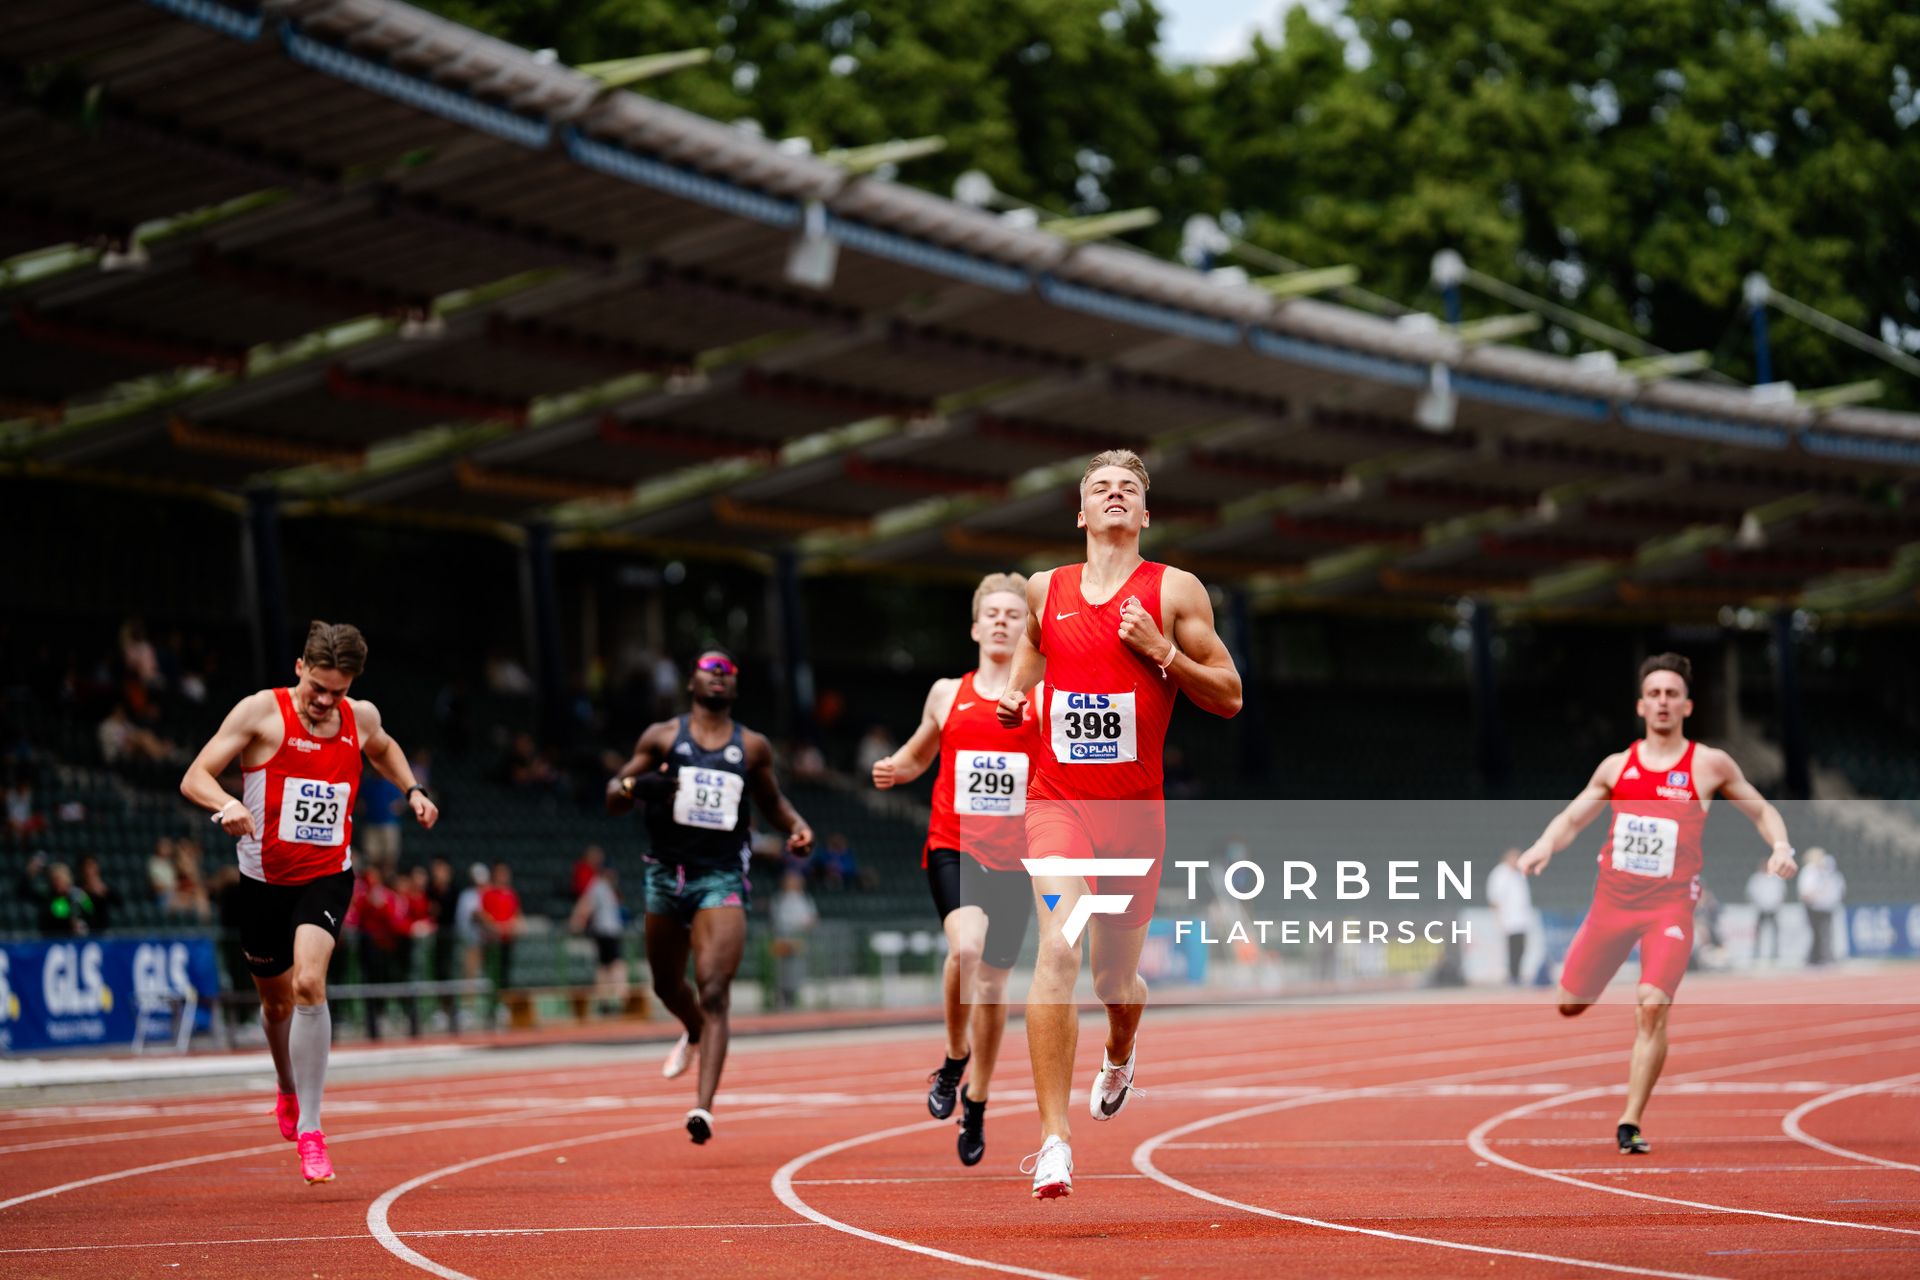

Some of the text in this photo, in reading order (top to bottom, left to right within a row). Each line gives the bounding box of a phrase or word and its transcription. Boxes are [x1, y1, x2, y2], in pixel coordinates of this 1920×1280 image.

[1065, 712, 1121, 739] 398
[1089, 745, 1116, 753] PLAN
[969, 772, 1014, 795] 299
[696, 788, 722, 808] 93
[294, 800, 339, 825] 523
[1624, 836, 1663, 857] 252
